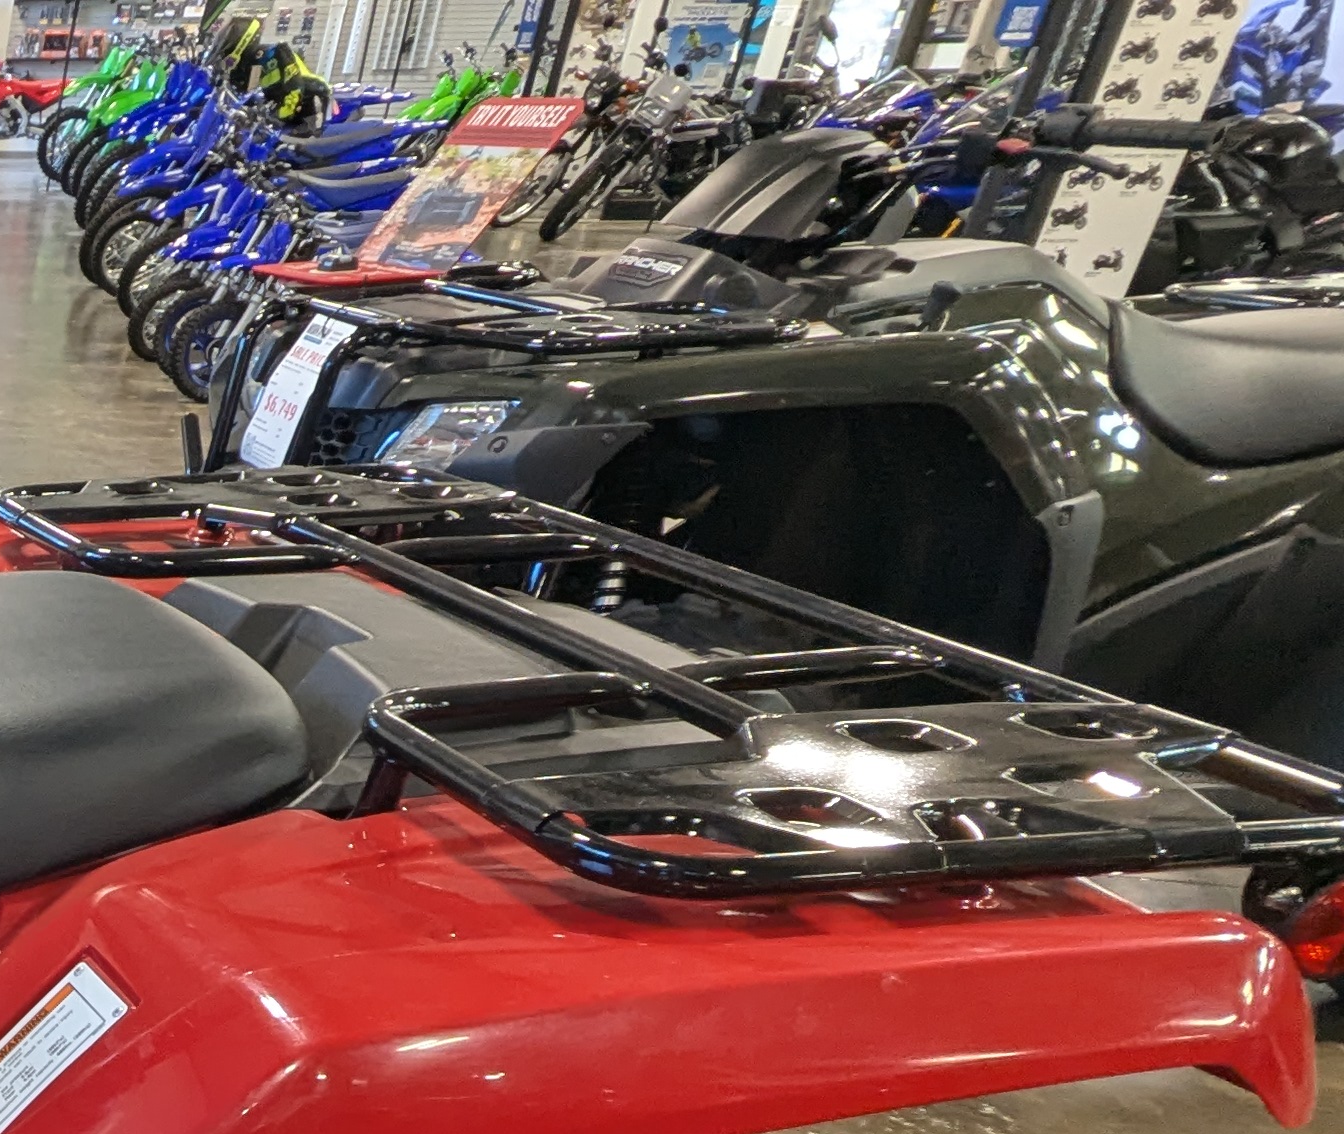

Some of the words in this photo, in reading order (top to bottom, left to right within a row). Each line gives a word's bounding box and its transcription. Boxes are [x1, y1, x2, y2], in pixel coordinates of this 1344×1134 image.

[467, 104, 498, 126] TRY
[489, 104, 512, 127] IT
[502, 104, 577, 127] YOURSELF
[306, 351, 327, 367] PRIC
[264, 392, 299, 422] $6,749
